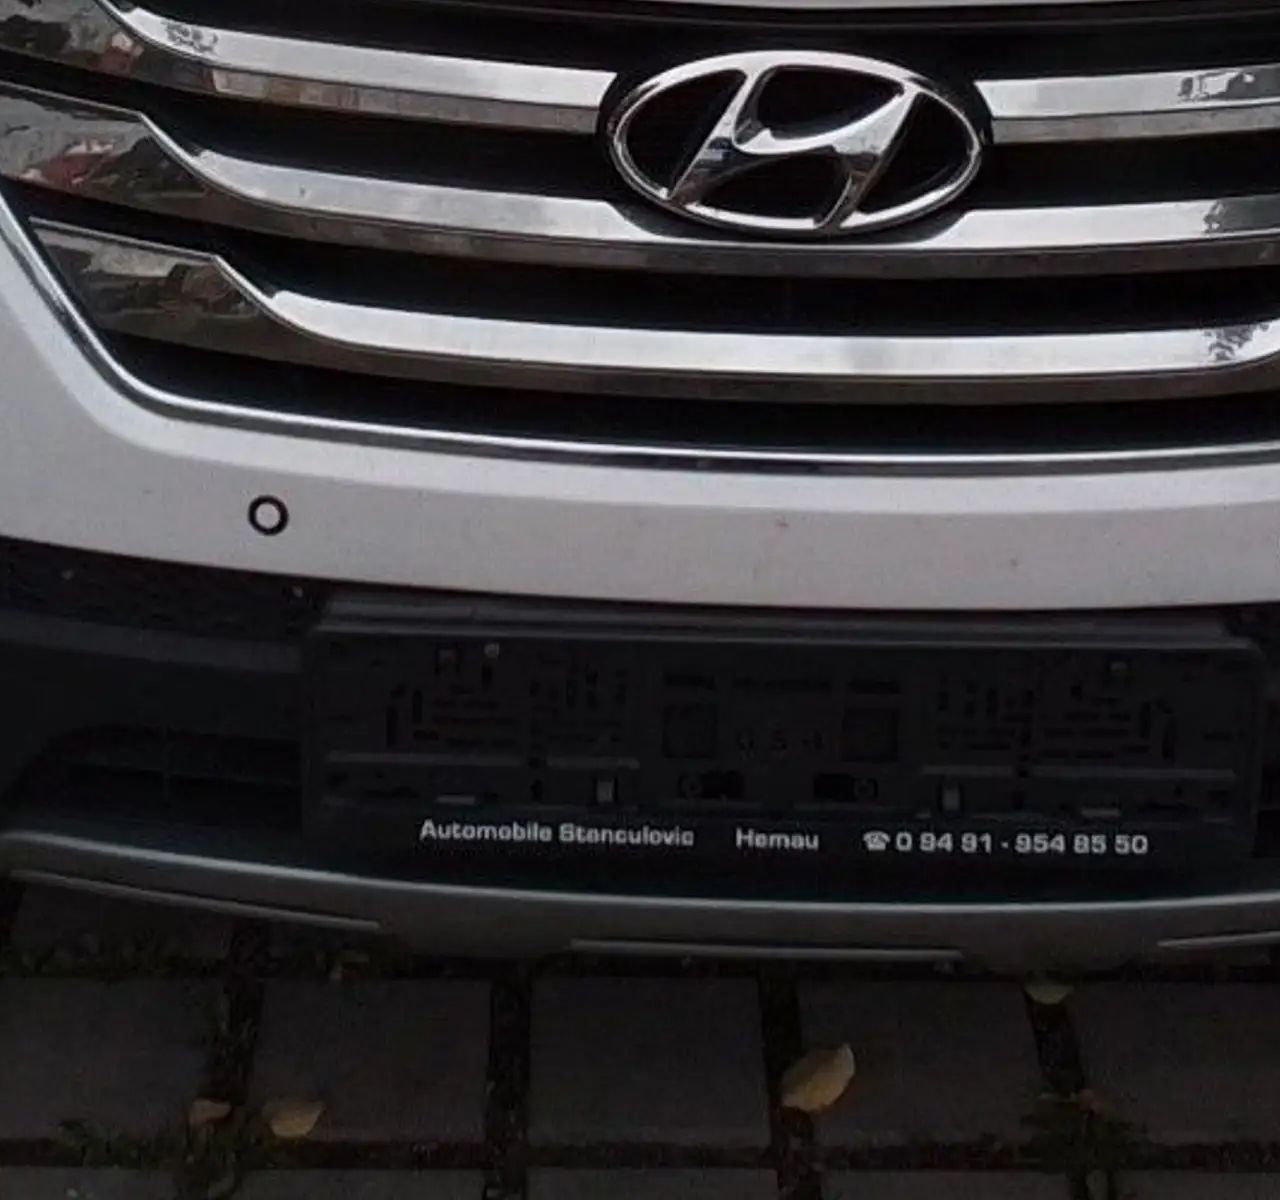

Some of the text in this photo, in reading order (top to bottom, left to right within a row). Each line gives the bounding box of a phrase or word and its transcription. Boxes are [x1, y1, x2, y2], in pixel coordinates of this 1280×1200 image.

[419, 819, 553, 842] Automobile
[735, 828, 820, 850] Hemau
[896, 832, 913, 851] 0
[961, 833, 992, 853] 91
[1014, 834, 1066, 854] 954
[1073, 834, 1108, 855] 85
[1115, 835, 1149, 855] 50
